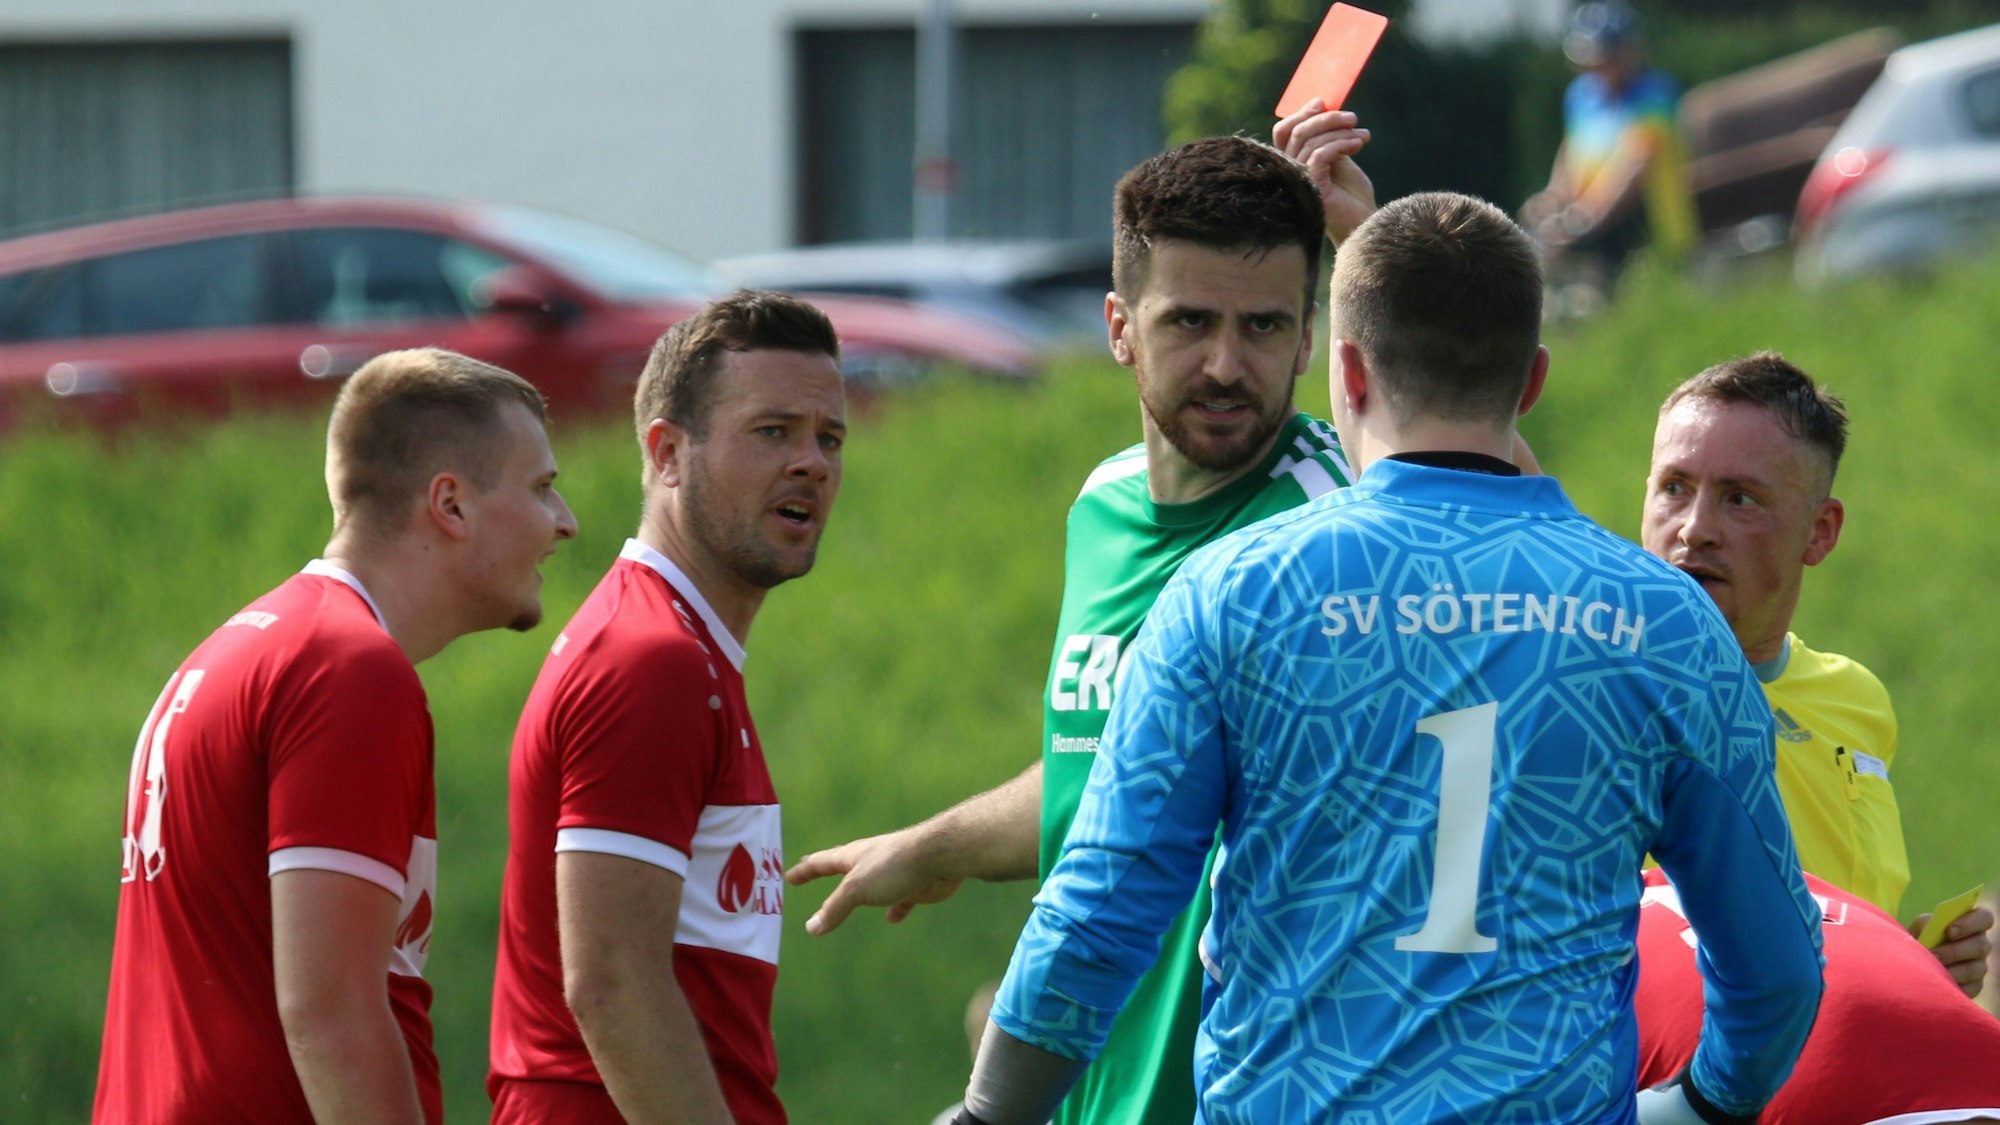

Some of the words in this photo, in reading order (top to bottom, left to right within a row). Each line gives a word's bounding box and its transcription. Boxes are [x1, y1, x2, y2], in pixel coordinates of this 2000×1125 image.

[1321, 595, 1380, 636] SV
[1396, 583, 1645, 653] SÖTENICH
[1051, 733, 1100, 753] Hammes
[1394, 701, 1498, 953] 1
